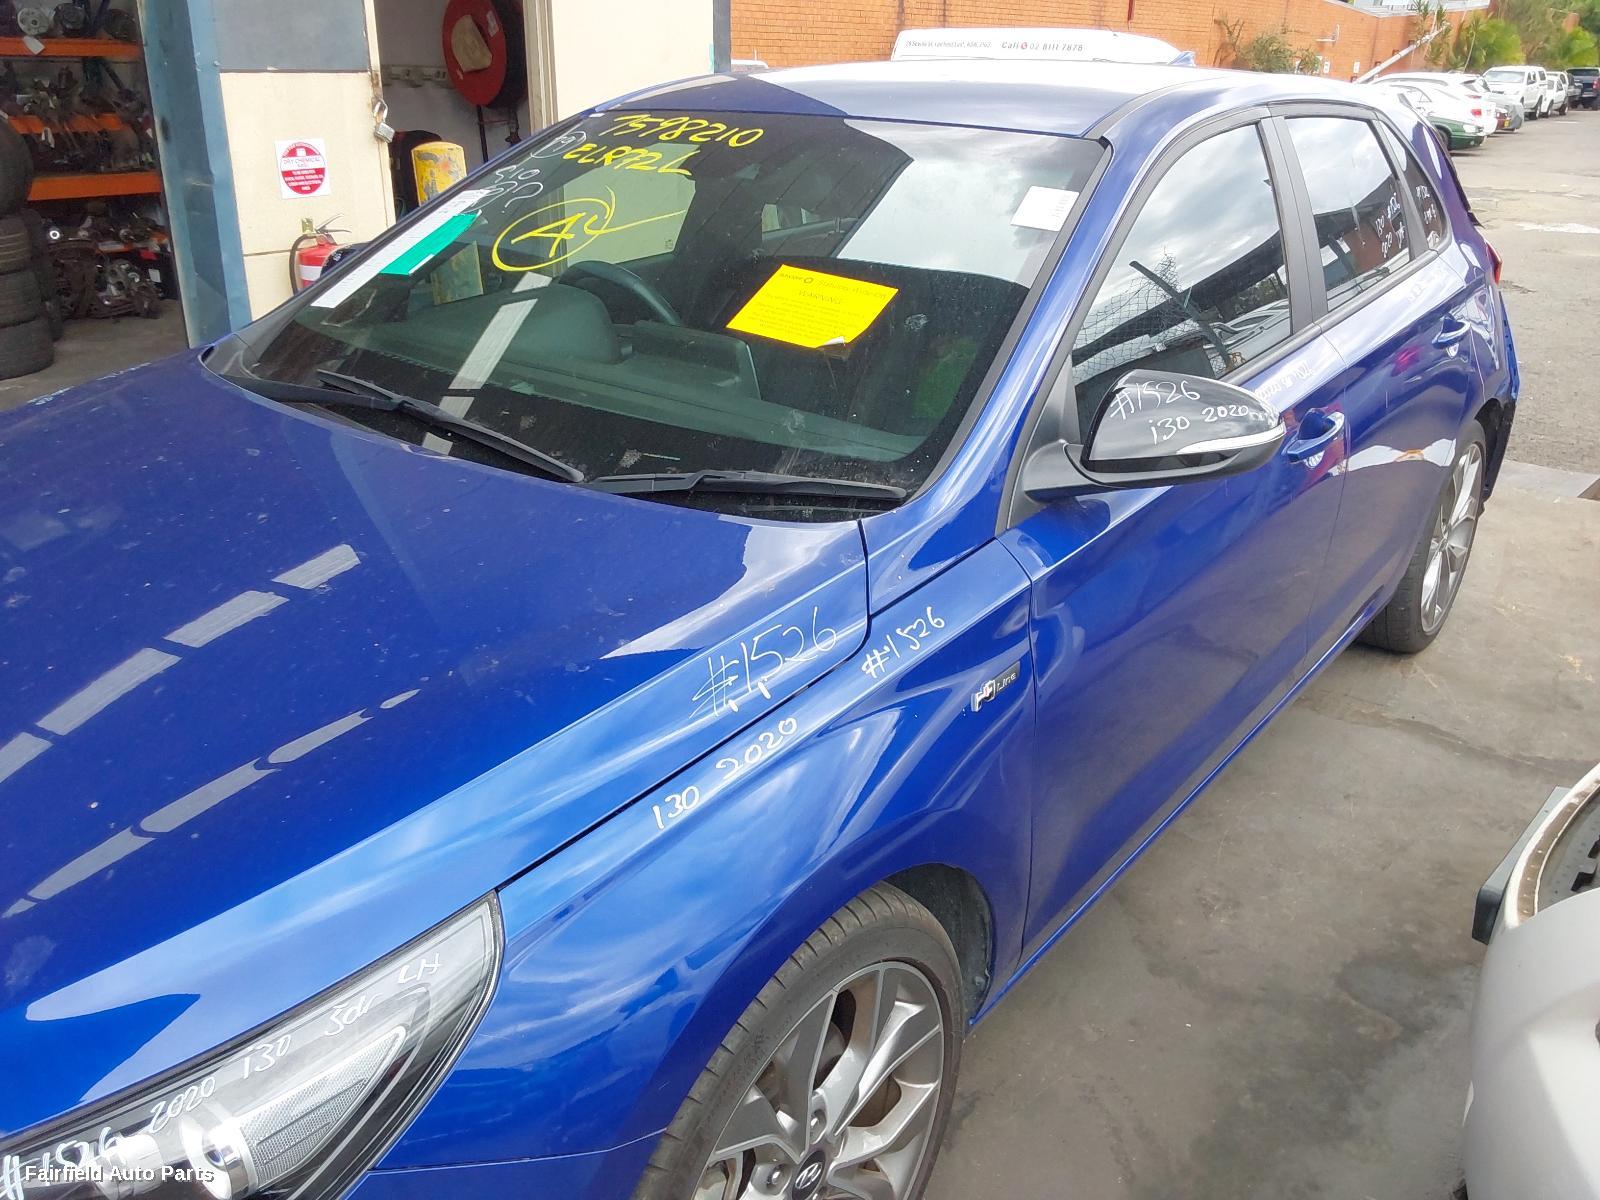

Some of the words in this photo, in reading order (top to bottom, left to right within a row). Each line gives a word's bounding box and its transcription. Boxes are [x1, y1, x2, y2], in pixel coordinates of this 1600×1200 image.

[1109, 381, 1201, 421] #1526
[1148, 416, 1191, 445] i30
[1202, 405, 1250, 422] 2020
[715, 717, 798, 781] 2020
[150, 1076, 216, 1134] 2020
